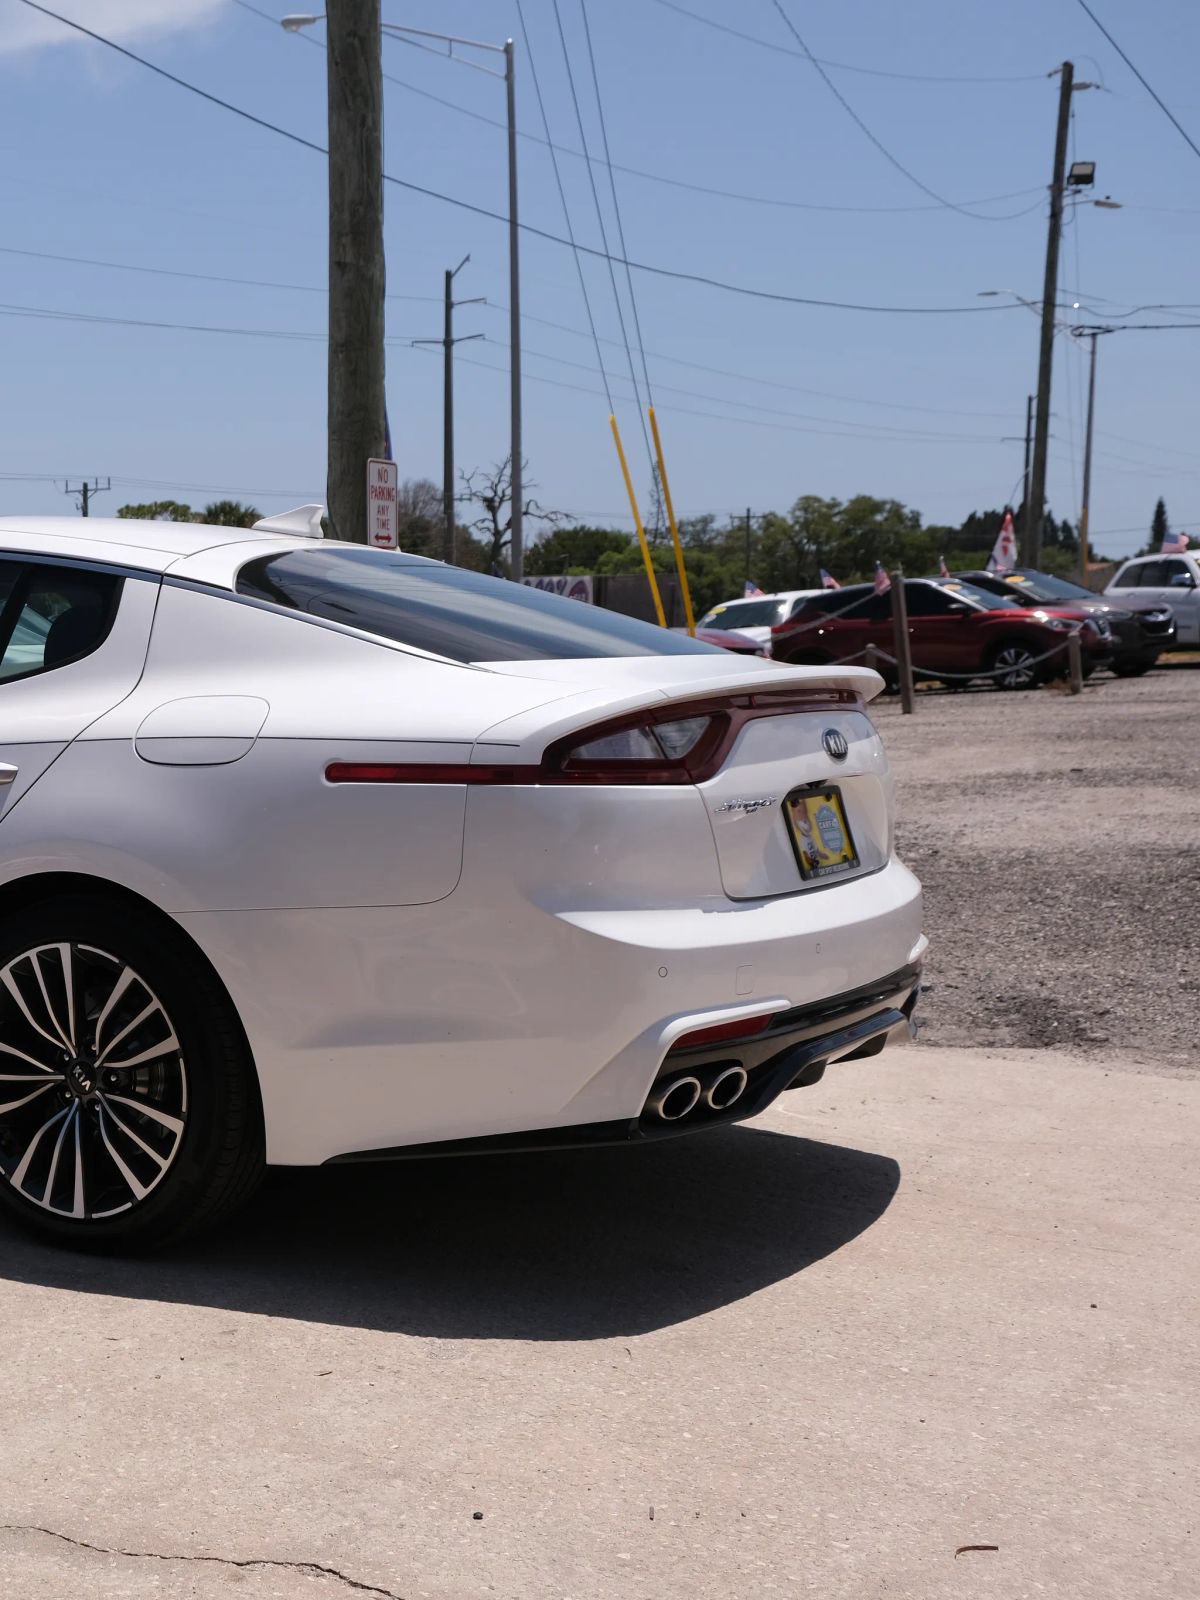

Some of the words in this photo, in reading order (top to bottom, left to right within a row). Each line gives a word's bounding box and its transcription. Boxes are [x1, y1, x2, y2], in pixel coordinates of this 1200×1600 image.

[377, 467, 389, 483] NO
[370, 485, 395, 502] PARKING
[377, 505, 390, 516] ANY
[377, 518, 390, 530] TIME
[826, 734, 848, 754] KIA
[73, 1065, 91, 1091] KIA
